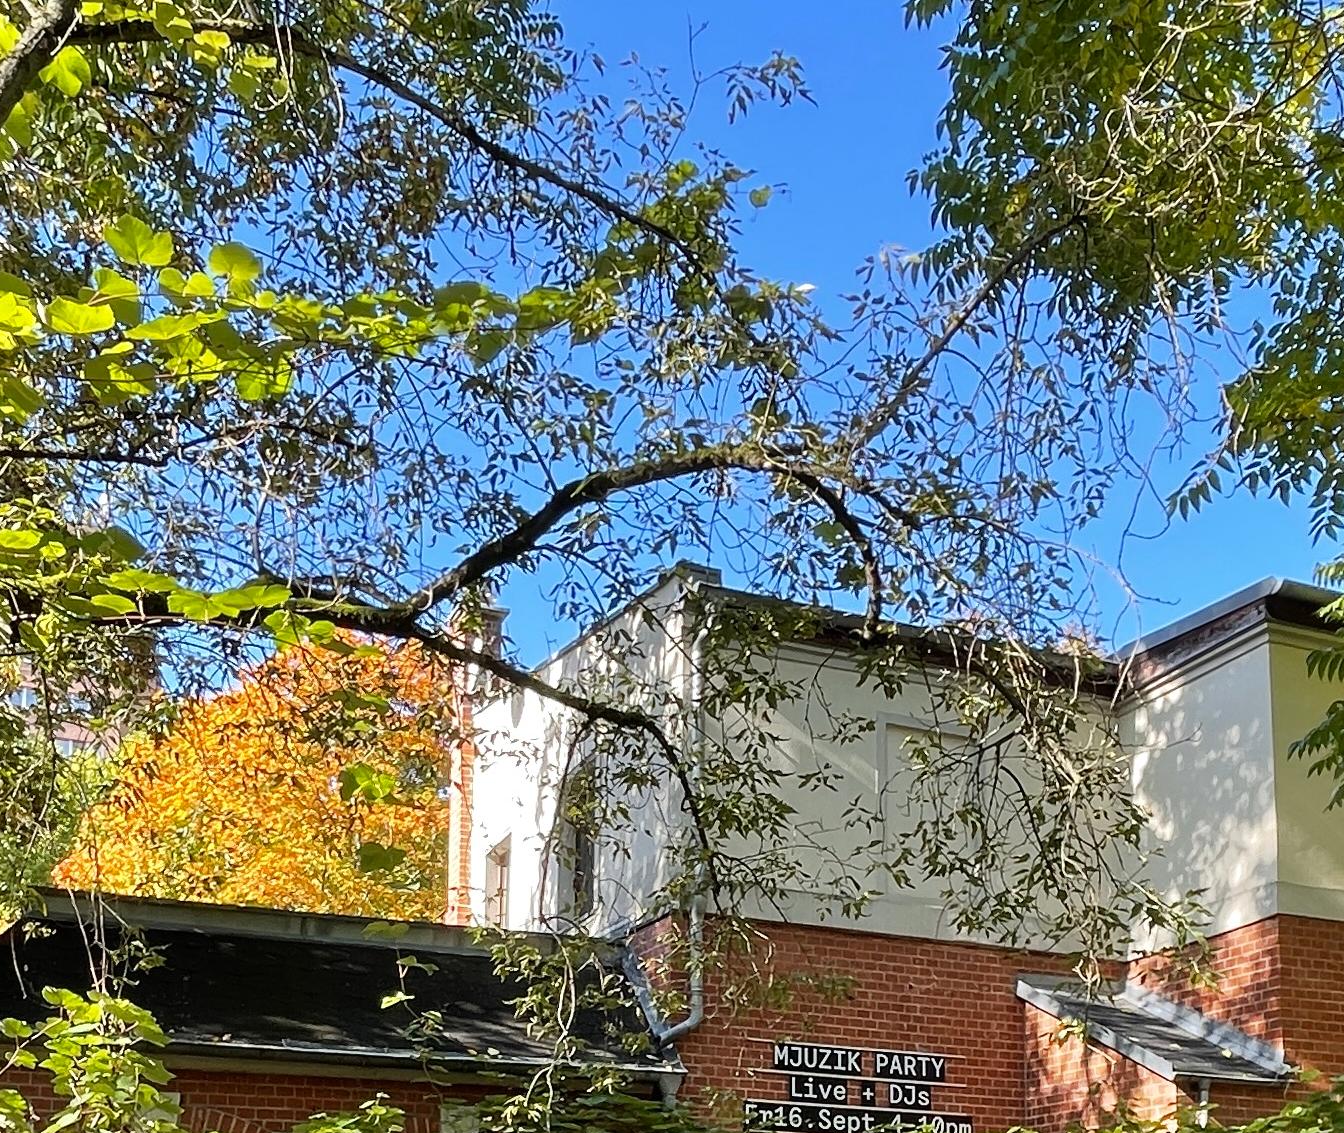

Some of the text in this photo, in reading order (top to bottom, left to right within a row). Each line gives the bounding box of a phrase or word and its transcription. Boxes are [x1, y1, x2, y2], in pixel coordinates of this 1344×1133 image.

[774, 1045, 944, 1078] MJUZIK PARTY
[791, 1077, 930, 1106] Live + DJs
